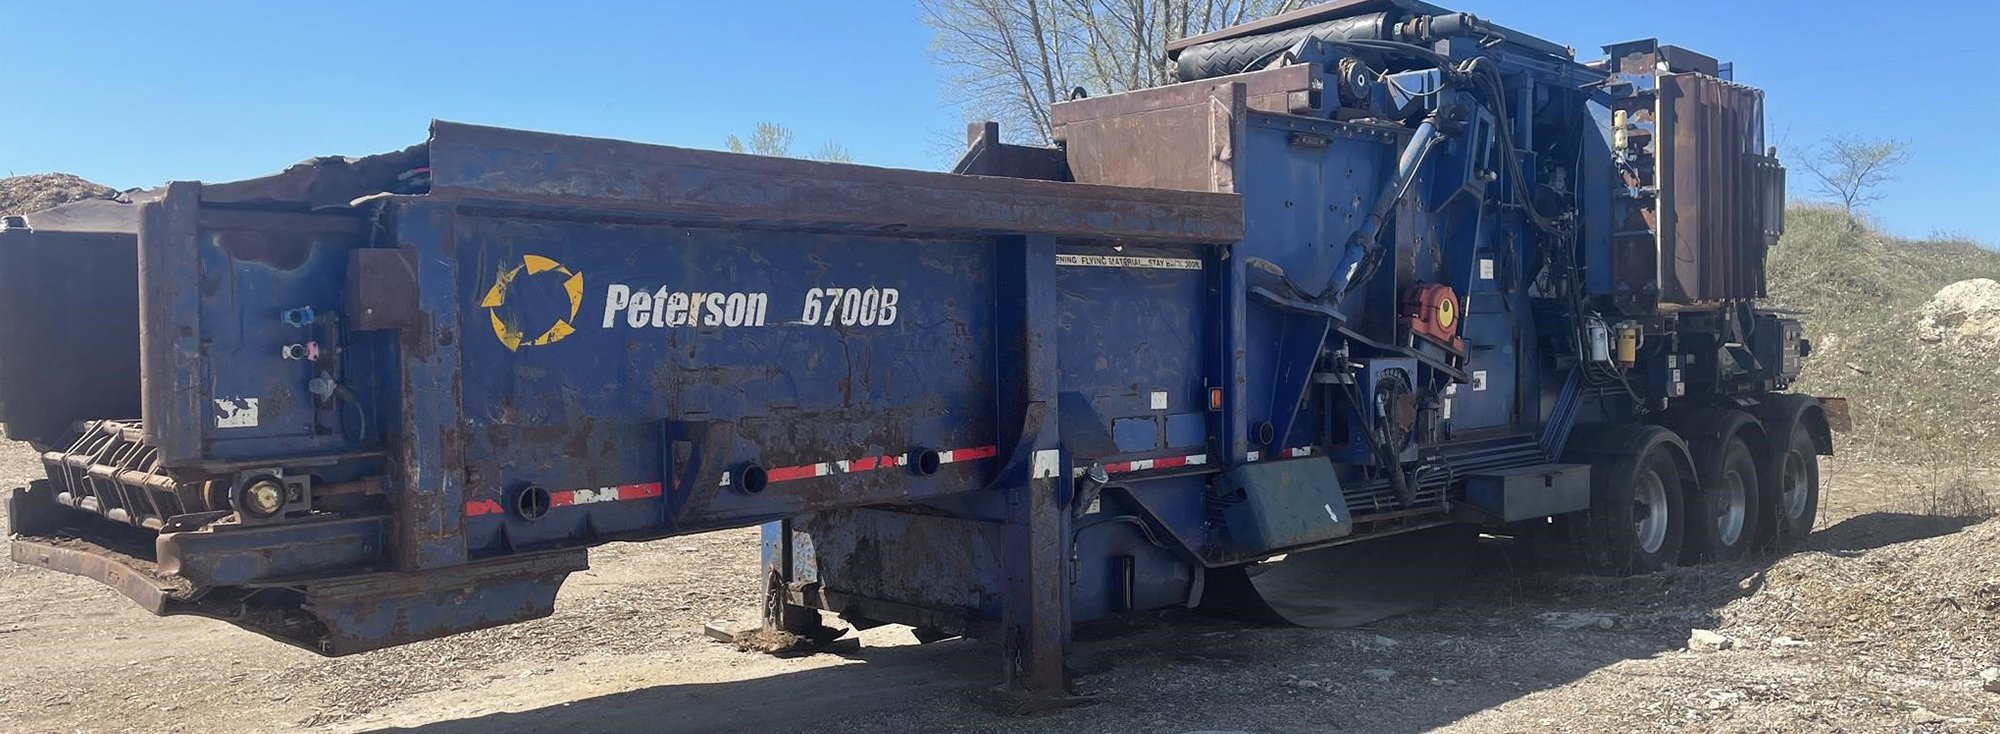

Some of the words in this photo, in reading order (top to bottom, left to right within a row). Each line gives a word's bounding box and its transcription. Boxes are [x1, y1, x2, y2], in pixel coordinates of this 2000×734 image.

[1081, 257, 1107, 265] FLYING
[1148, 259, 1164, 267] STAY
[602, 284, 768, 328] Peterson
[801, 287, 900, 327] 6700B
